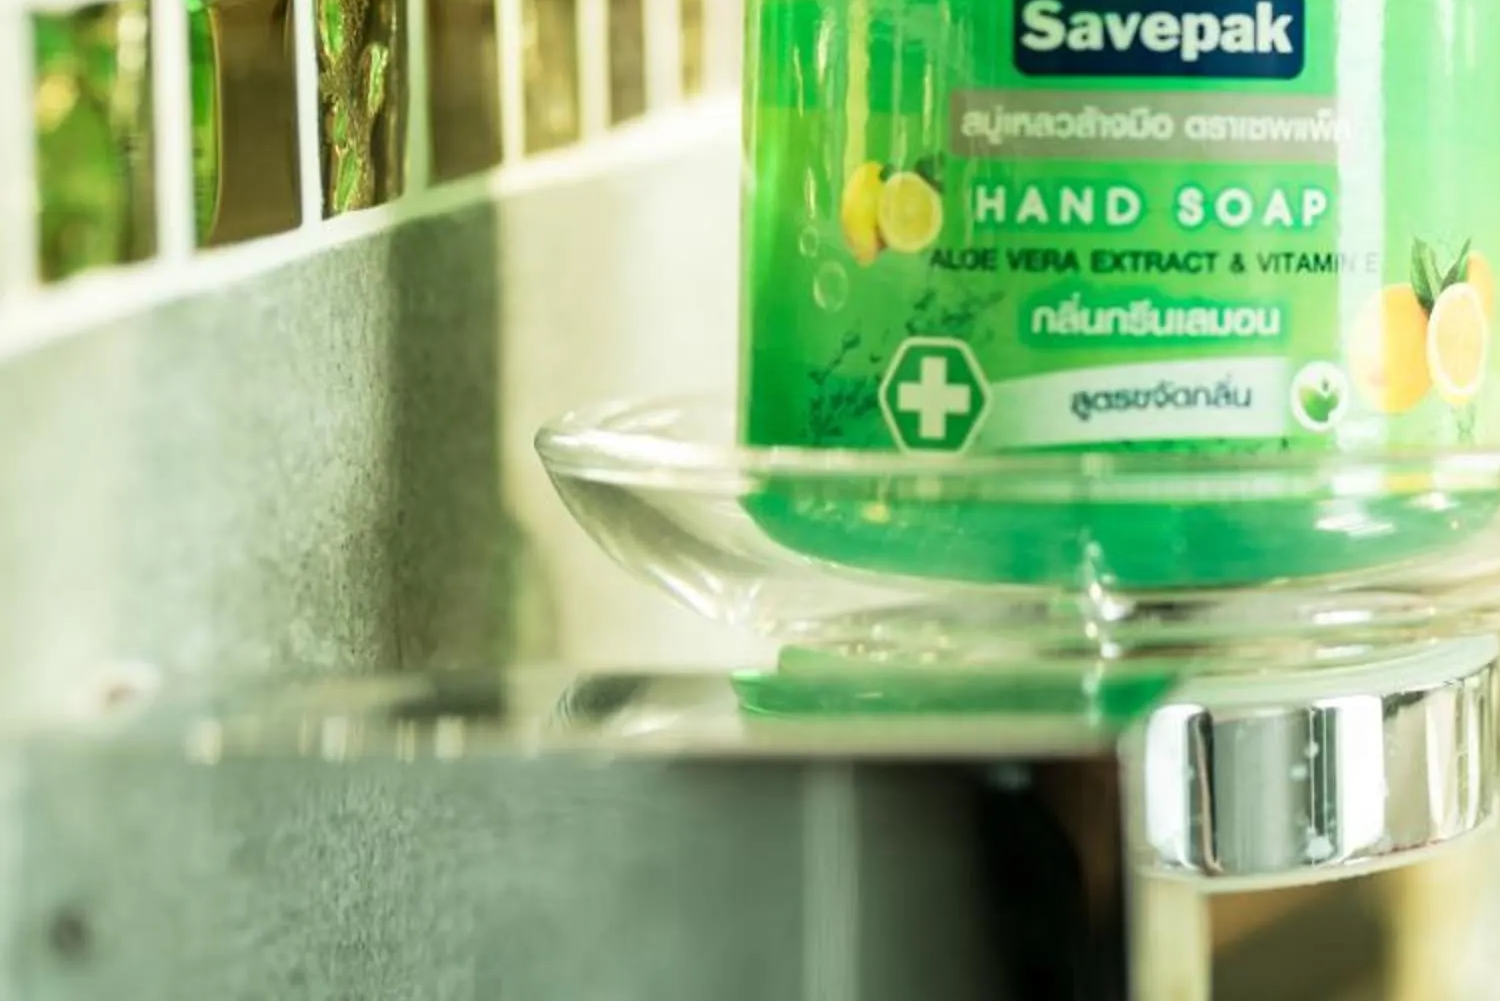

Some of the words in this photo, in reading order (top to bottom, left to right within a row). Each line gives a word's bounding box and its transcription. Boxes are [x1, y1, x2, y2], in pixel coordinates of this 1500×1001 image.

[976, 186, 1141, 224] HAND
[1178, 187, 1328, 226] SOAP
[930, 249, 996, 271] ALOE
[1006, 250, 1078, 273] VERA
[1091, 251, 1217, 273] EXTRACT
[1230, 252, 1245, 273] &
[1256, 251, 1356, 274] VITAMIN
[1365, 252, 1379, 273] E
